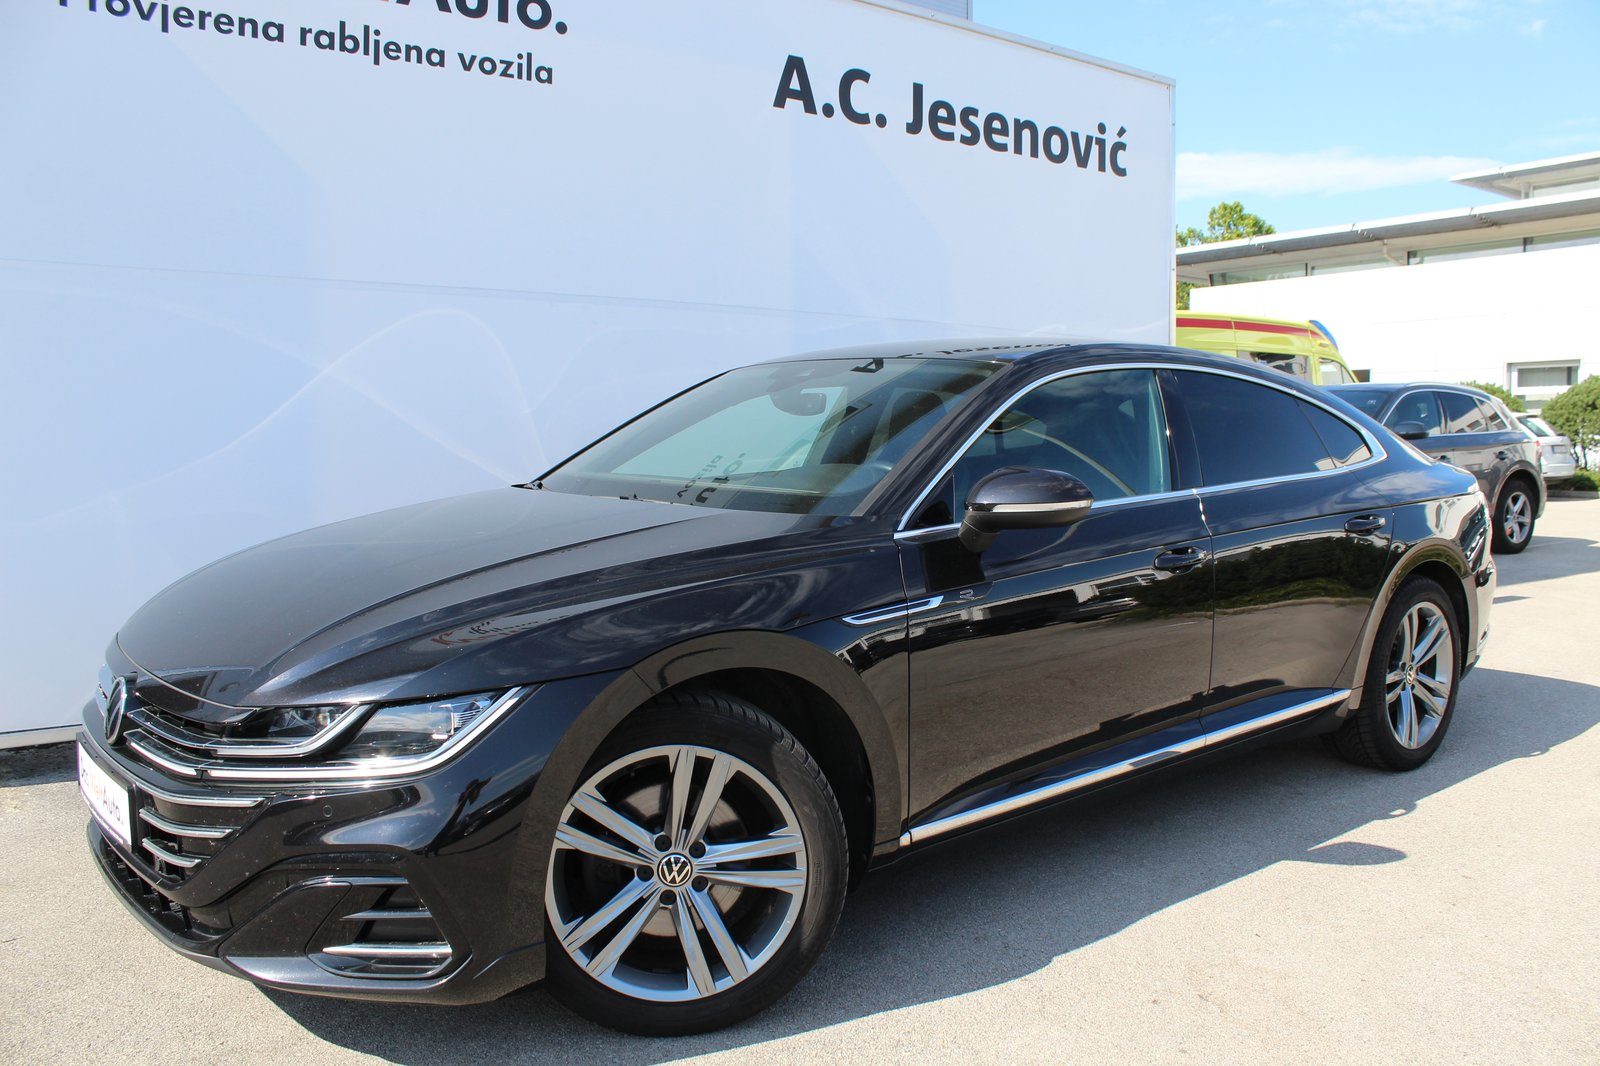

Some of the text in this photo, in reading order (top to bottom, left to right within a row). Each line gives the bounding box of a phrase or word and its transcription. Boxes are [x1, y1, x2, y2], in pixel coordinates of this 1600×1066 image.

[60, 0, 553, 85] rovjerena rabljena vozila
[772, 54, 1127, 177] A.C. Jesenović
